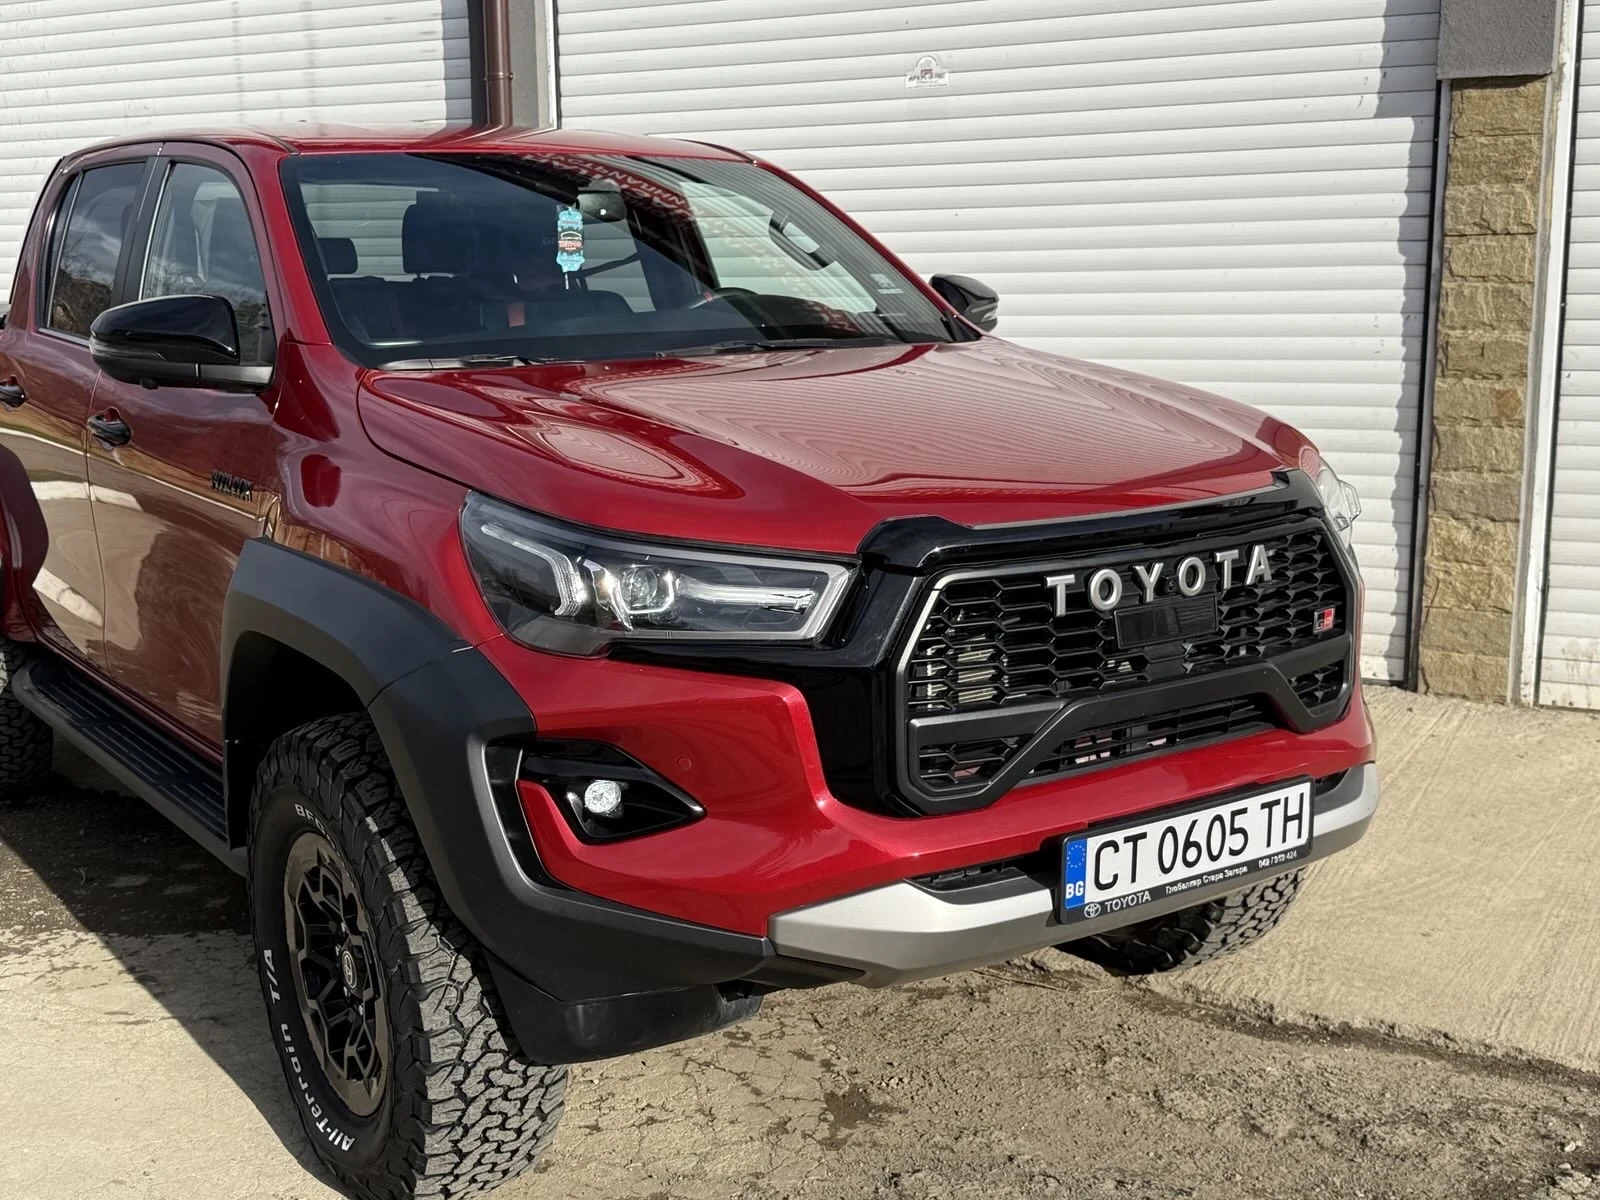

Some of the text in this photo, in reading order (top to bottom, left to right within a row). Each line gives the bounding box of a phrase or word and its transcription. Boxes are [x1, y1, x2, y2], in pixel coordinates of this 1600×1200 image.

[1046, 544, 1272, 617] TOYOTA
[1094, 792, 1304, 891] CT 0605 TH
[1066, 881, 1084, 899] BG
[1202, 872, 1224, 883] Стара
[1224, 866, 1248, 878] Загора
[1104, 891, 1151, 913] TOYOTA
[264, 949, 355, 1151] All-Terrain T/A
